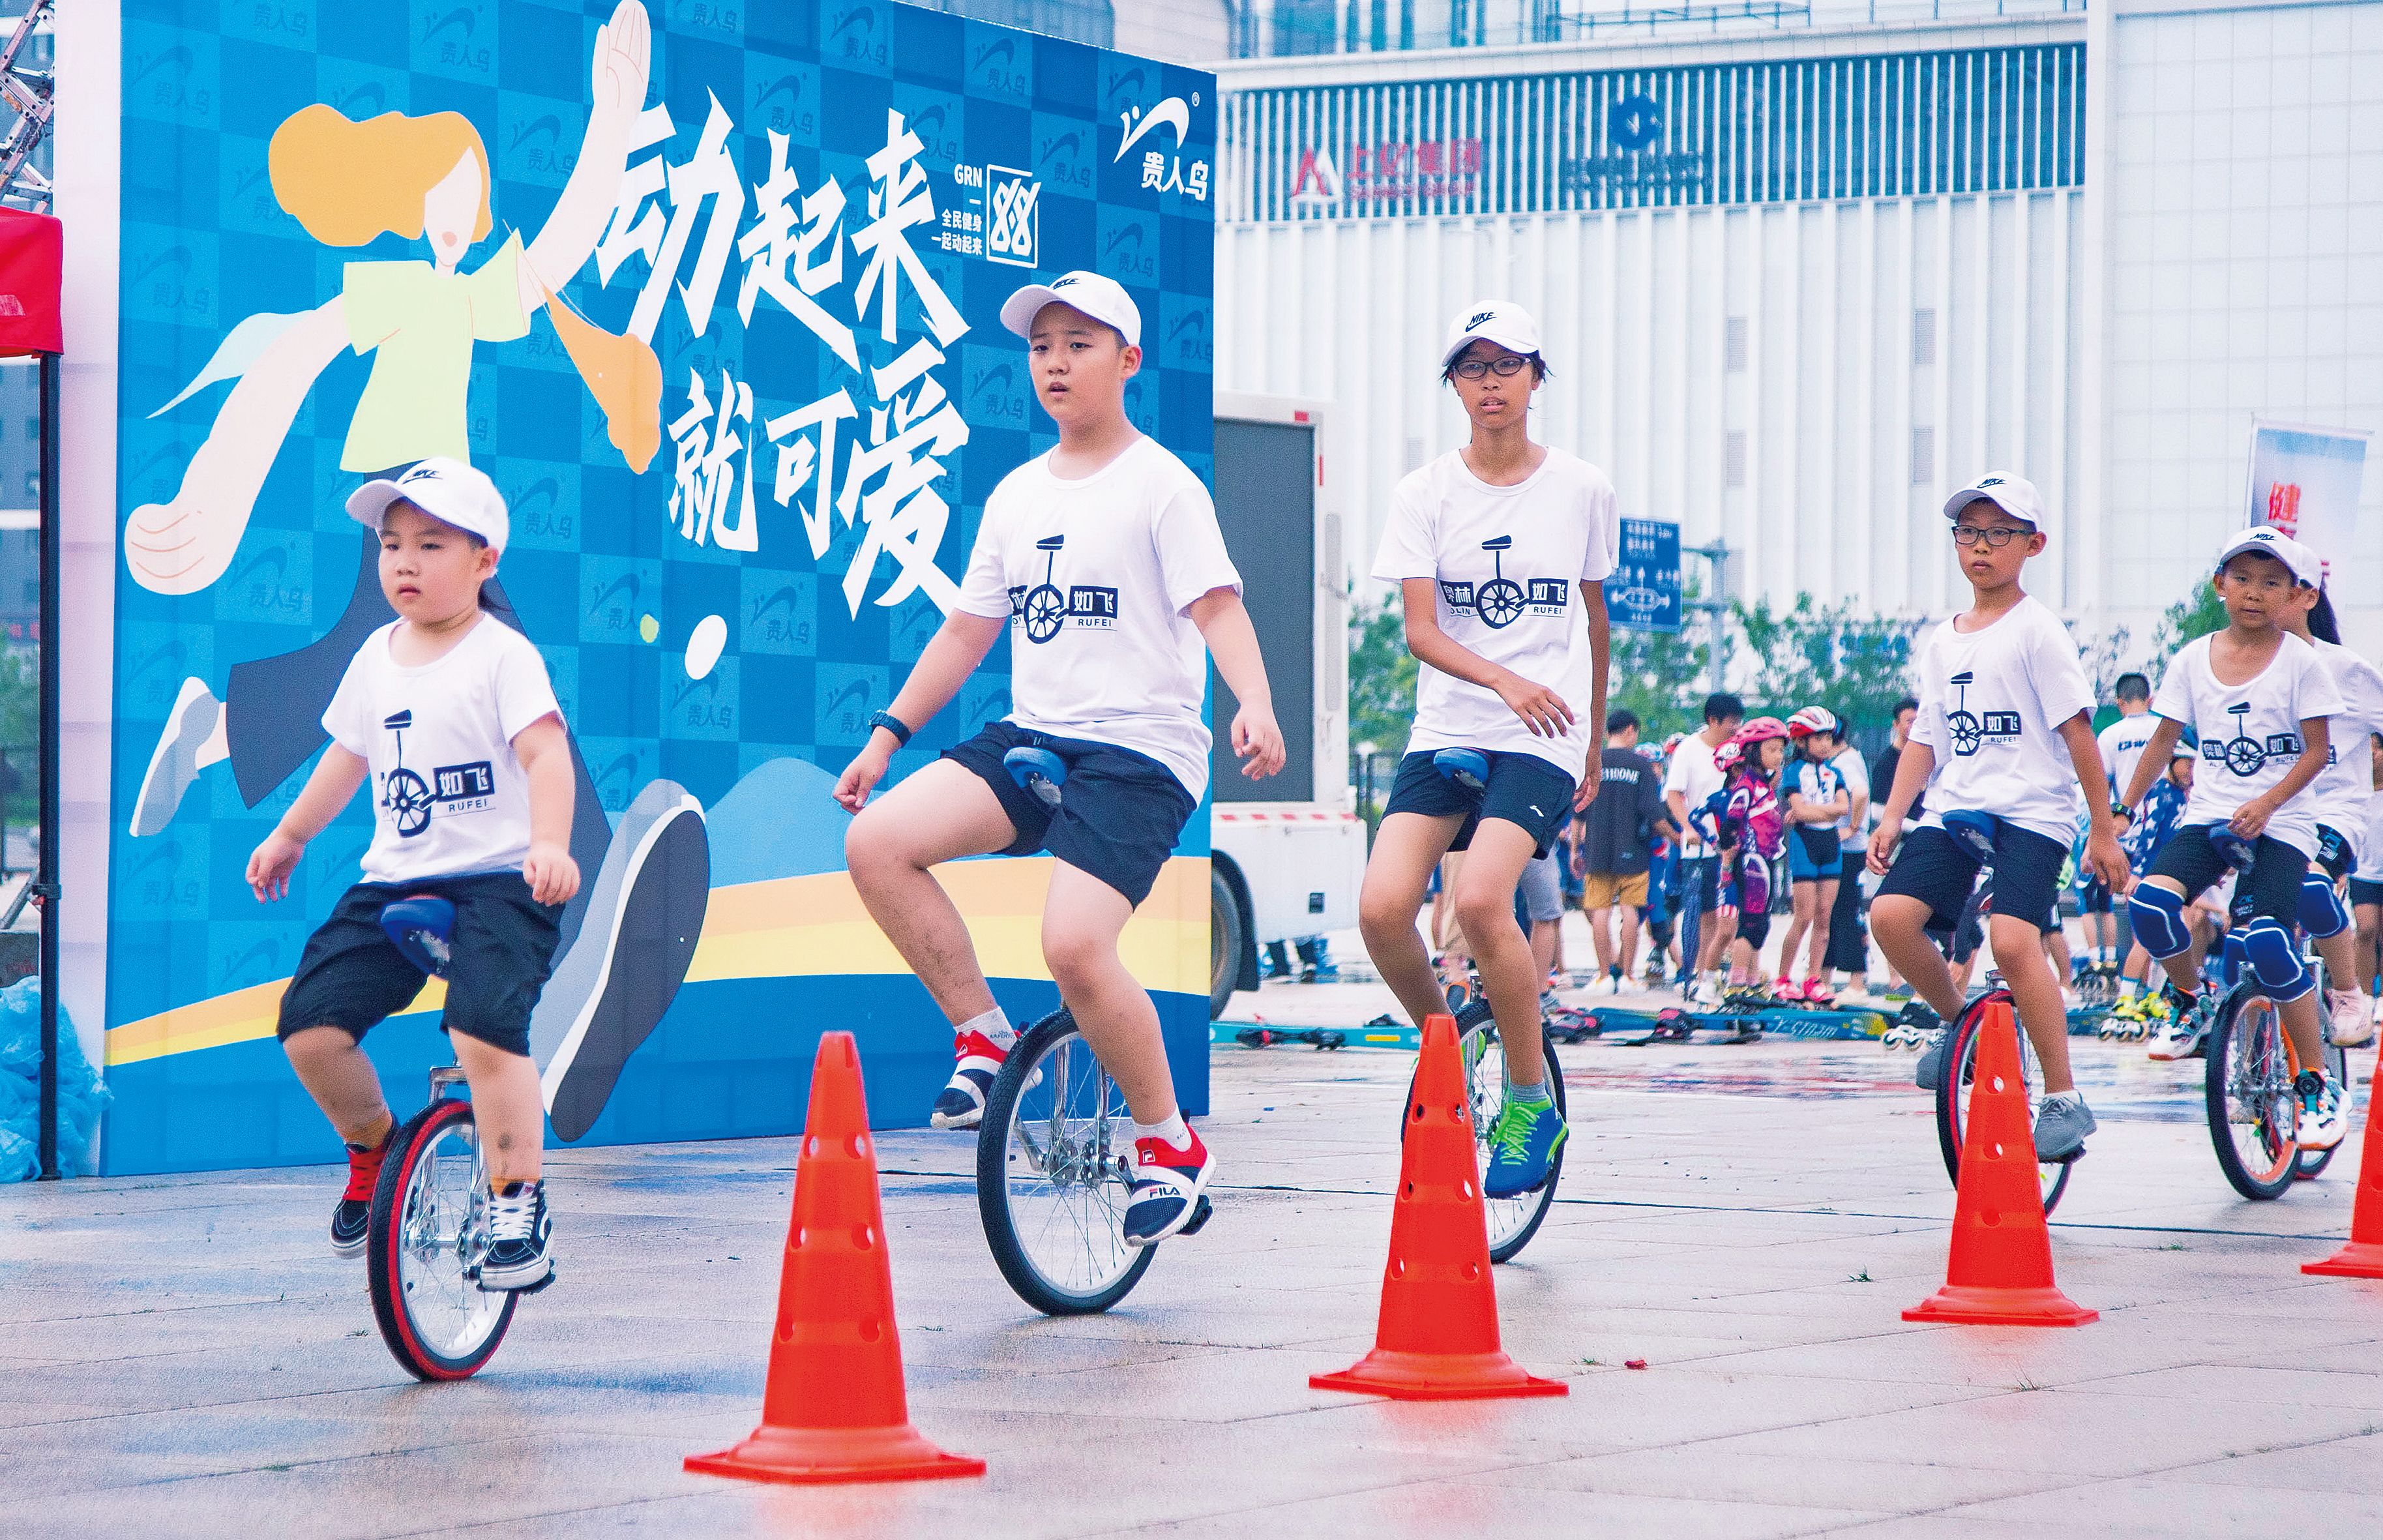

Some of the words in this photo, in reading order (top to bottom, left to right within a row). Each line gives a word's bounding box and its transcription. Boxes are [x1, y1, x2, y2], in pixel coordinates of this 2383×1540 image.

[954, 164, 983, 188] GRN
[1141, 151, 1208, 201] 贵人鸟
[941, 208, 982, 232] 全民健身
[931, 231, 983, 256] 一起动起来
[1468, 312, 1496, 326] NIKE
[667, 335, 969, 622] 就可爱
[1074, 591, 1114, 614] 如飞
[1533, 583, 1565, 601] 如飞
[1534, 606, 1562, 615] RUFEI
[1078, 619, 1112, 627] RUFEI
[439, 767, 488, 797] 如飞
[449, 799, 488, 813] RUFEI
[1149, 1187, 1181, 1198] FILA
